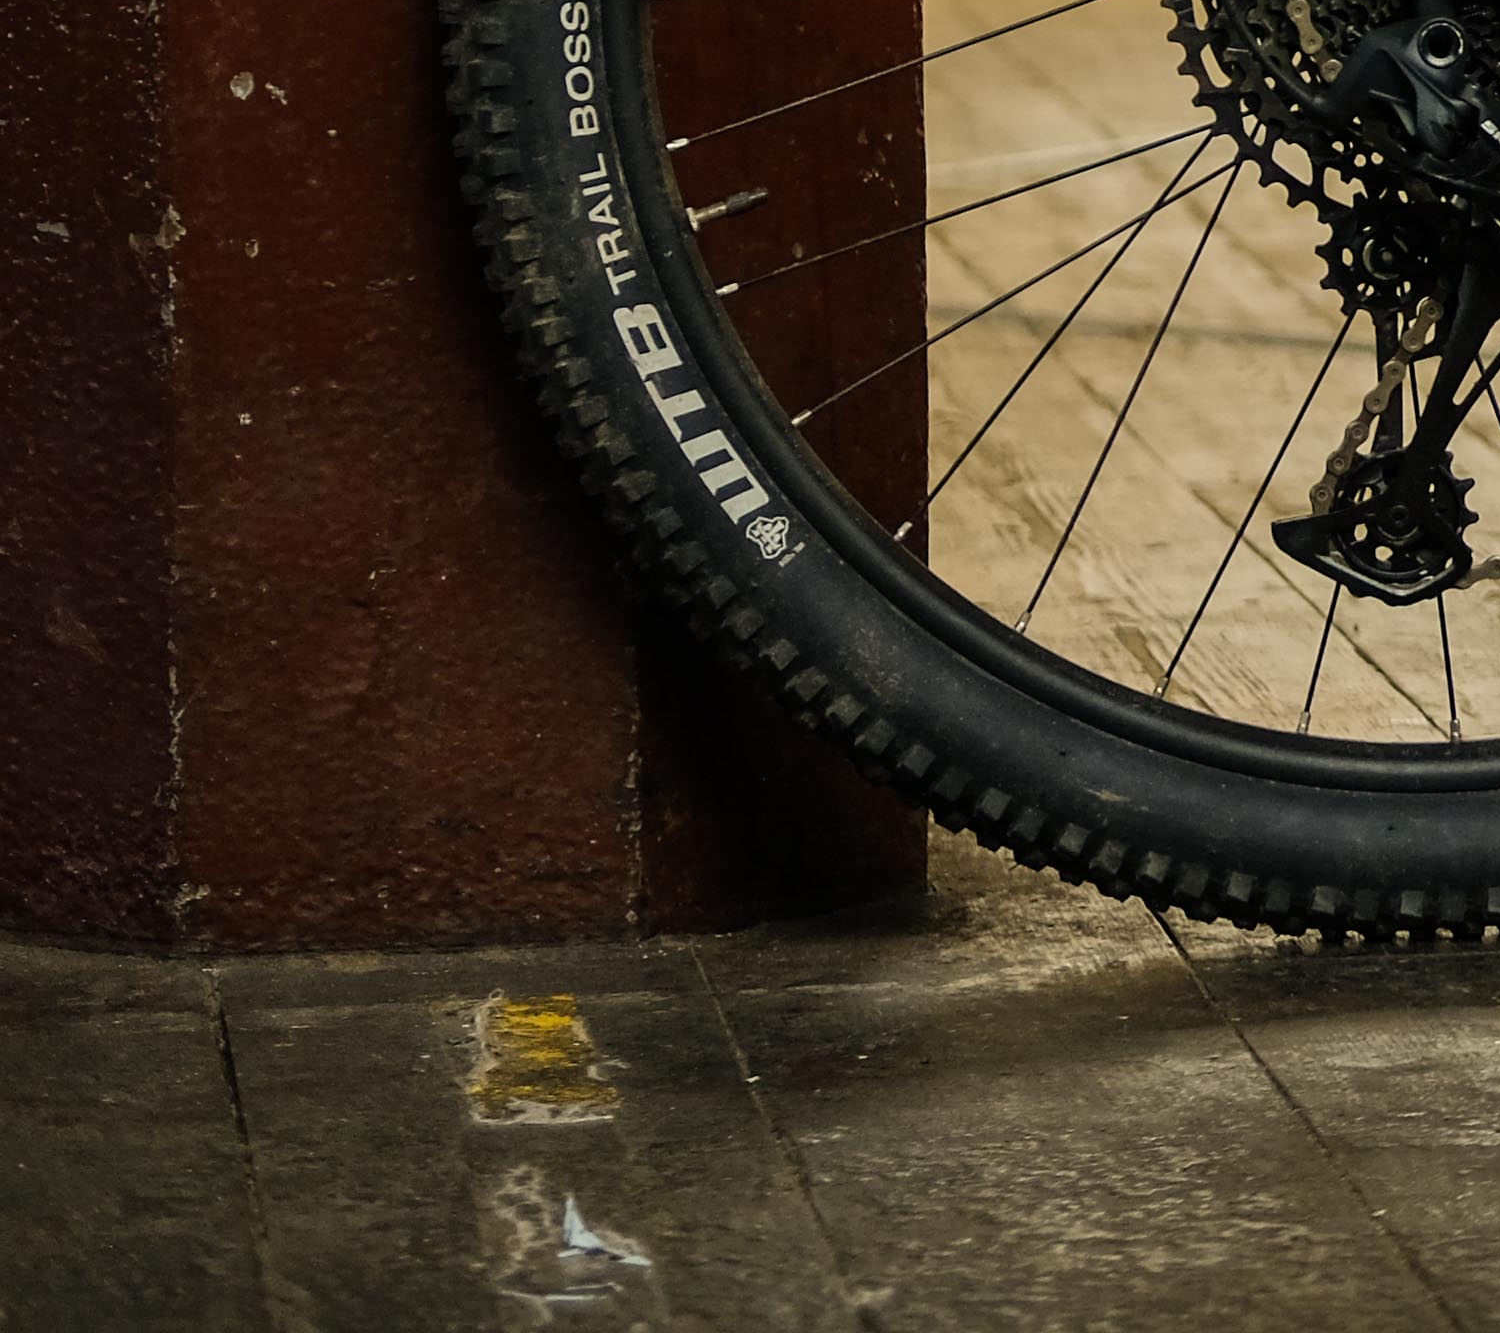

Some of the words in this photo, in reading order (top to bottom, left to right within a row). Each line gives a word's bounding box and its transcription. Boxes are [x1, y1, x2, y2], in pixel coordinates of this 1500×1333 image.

[560, 1, 600, 137] BOSS
[579, 152, 637, 296] TRAIL
[613, 303, 769, 524] WTB
